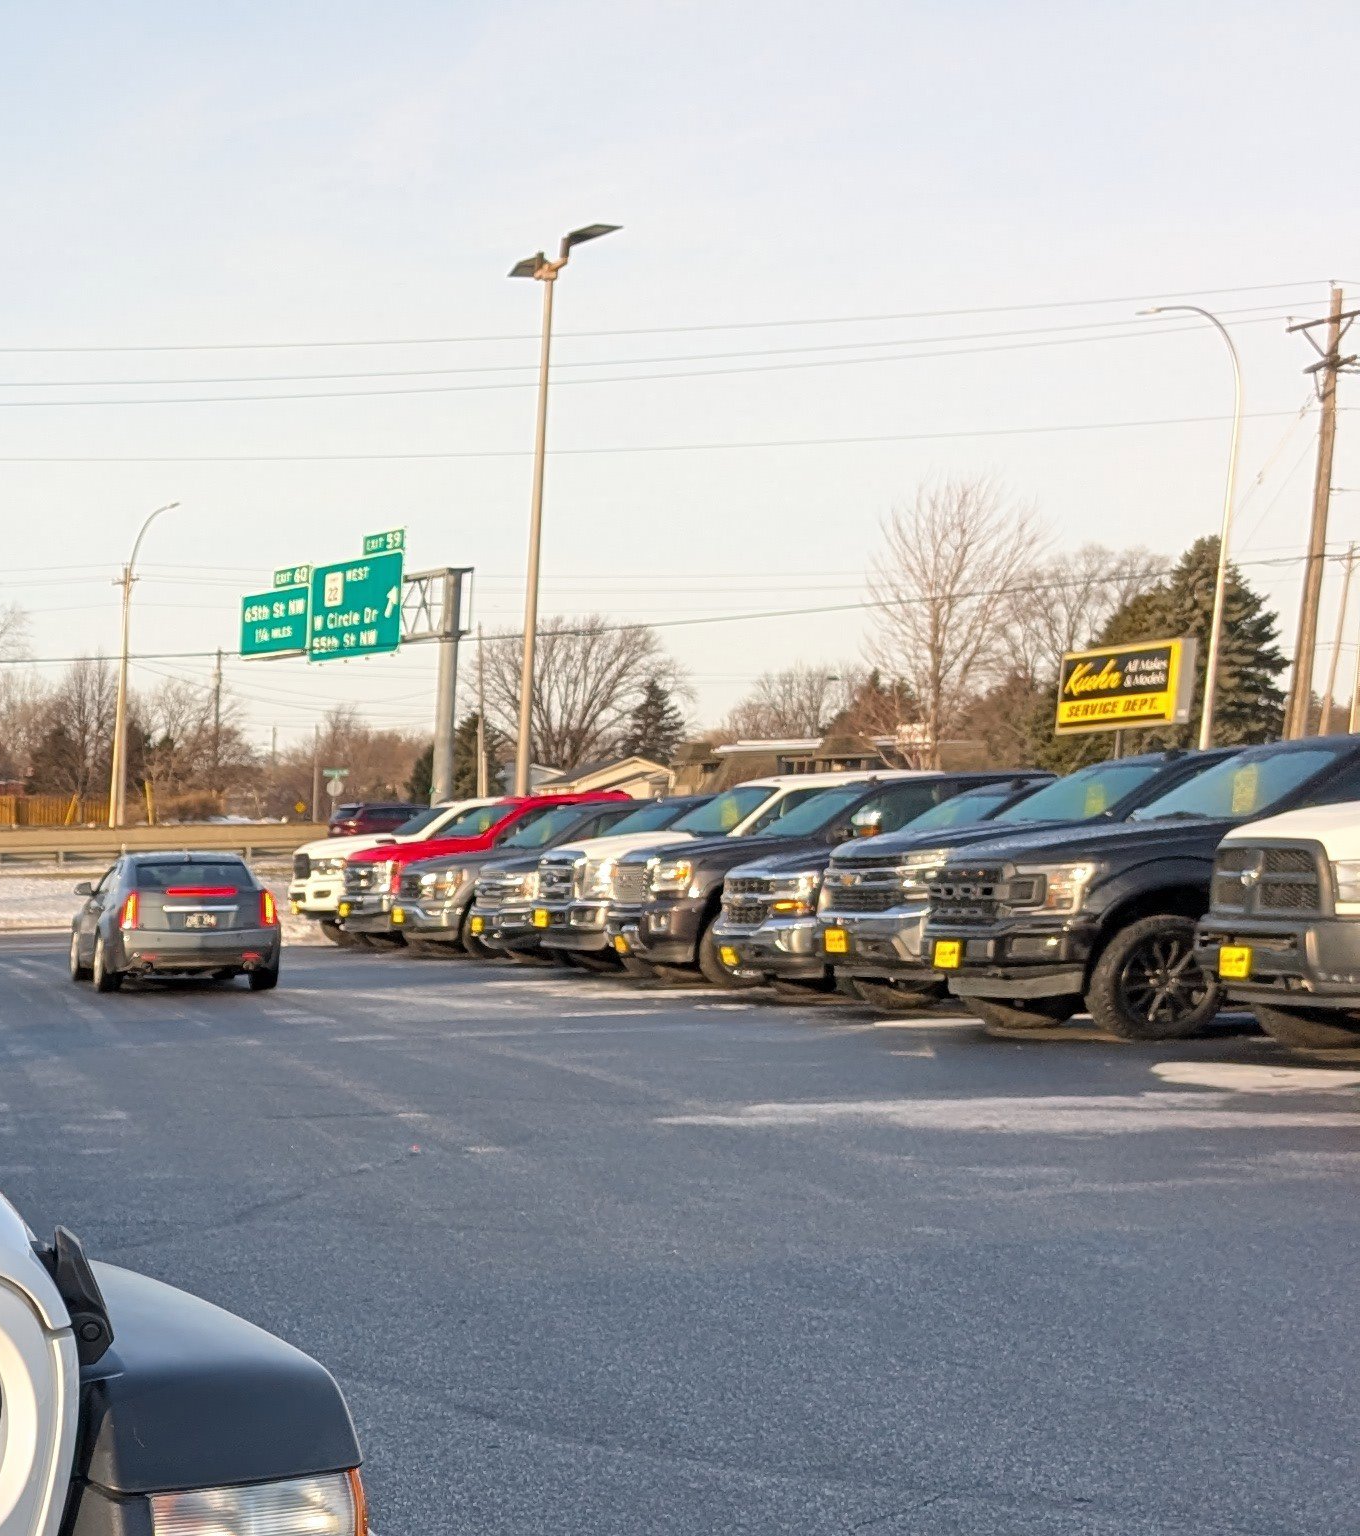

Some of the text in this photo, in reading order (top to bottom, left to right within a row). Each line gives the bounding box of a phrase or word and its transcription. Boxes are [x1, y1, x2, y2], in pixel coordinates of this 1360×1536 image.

[386, 531, 401, 549] 59
[294, 567, 308, 583] 60
[346, 567, 369, 581] WEST
[327, 587, 338, 602] 22
[245, 599, 305, 622] 65th St NW
[313, 607, 378, 631] W Circle Dr
[343, 632, 357, 648] St
[360, 629, 378, 646] NW
[1064, 659, 1122, 696] Kuehn
[1124, 659, 1139, 673] All
[1123, 671, 1167, 688] & Models
[1068, 698, 1157, 717] SERVICE DEPT.
